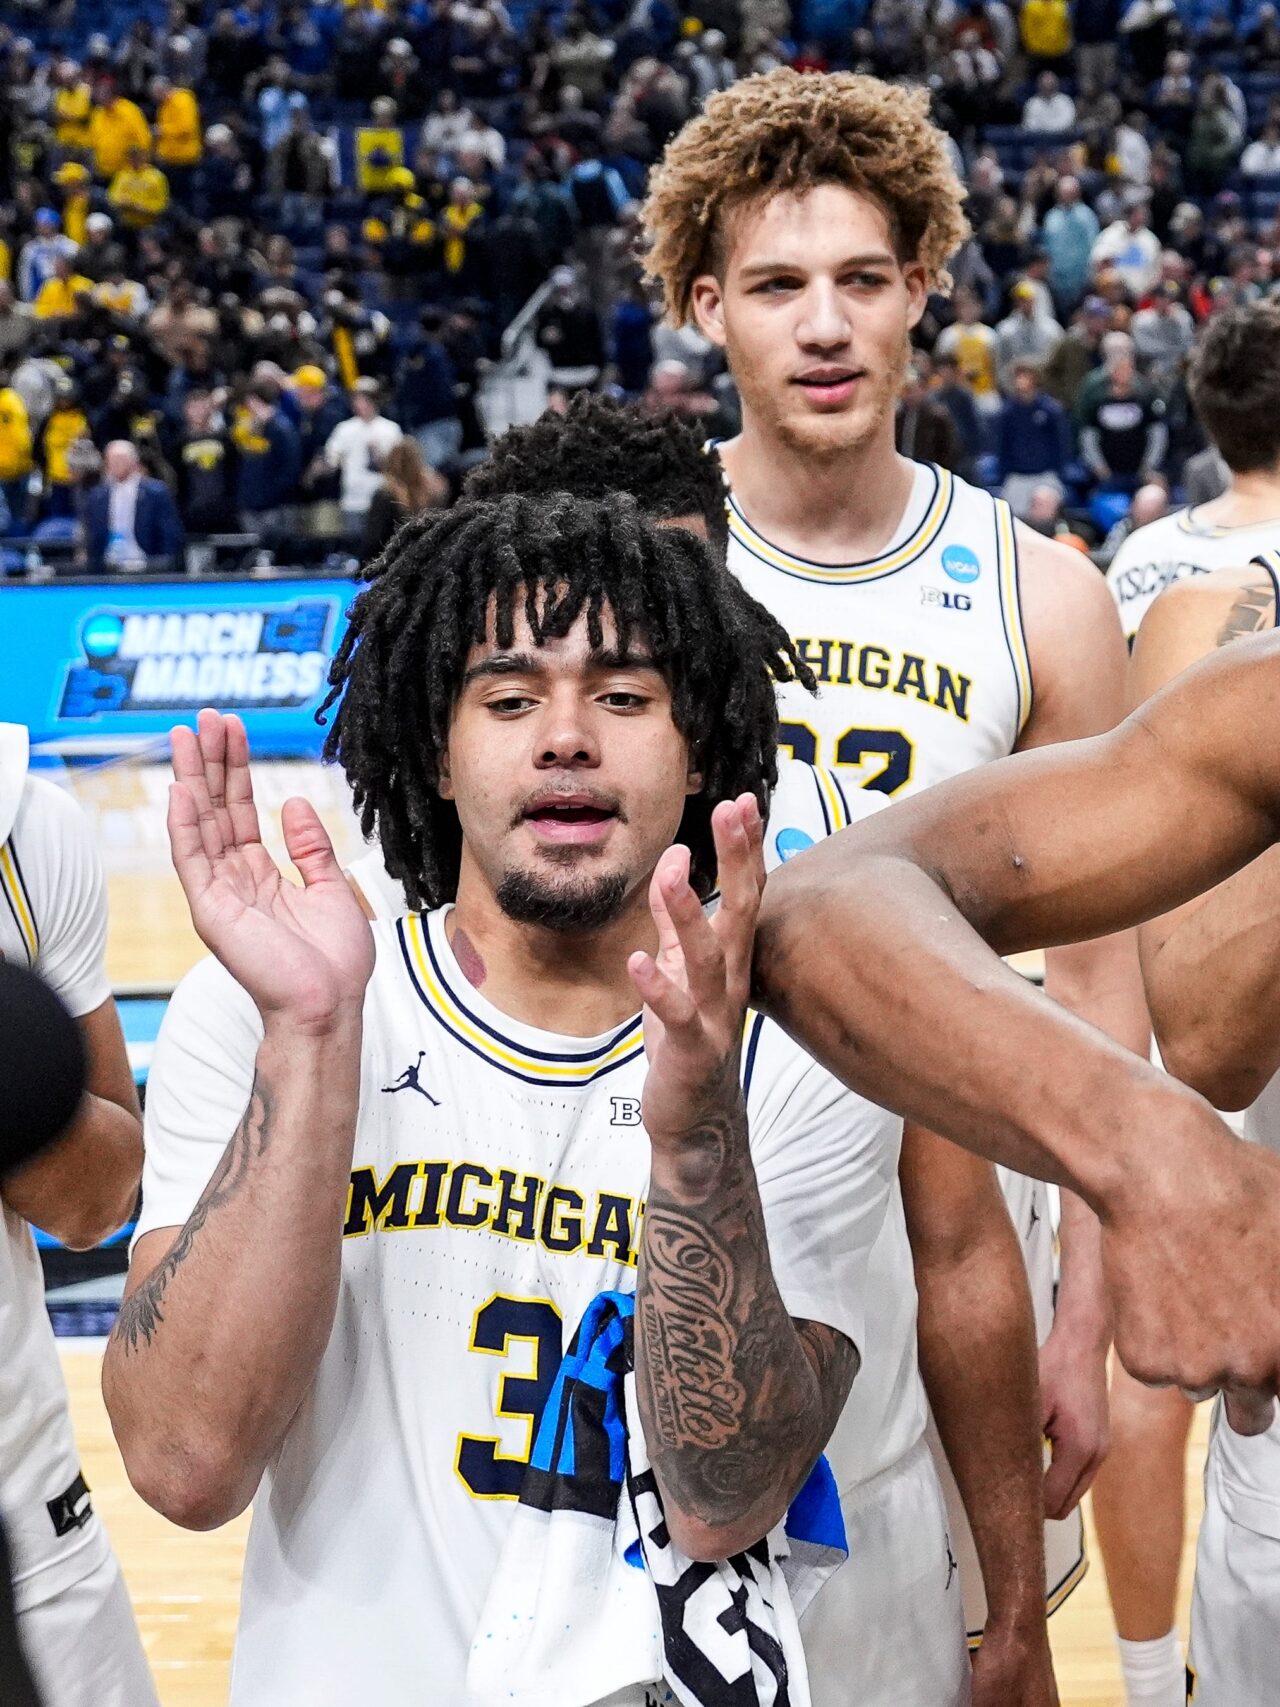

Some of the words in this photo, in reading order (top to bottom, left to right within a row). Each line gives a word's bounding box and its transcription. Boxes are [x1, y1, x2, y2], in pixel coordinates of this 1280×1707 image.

[116, 613, 265, 660] MARCH
[130, 651, 327, 701] MADNESS
[768, 637, 972, 722] HIGAN
[778, 719, 916, 797] 2
[453, 1291, 563, 1501] 3
